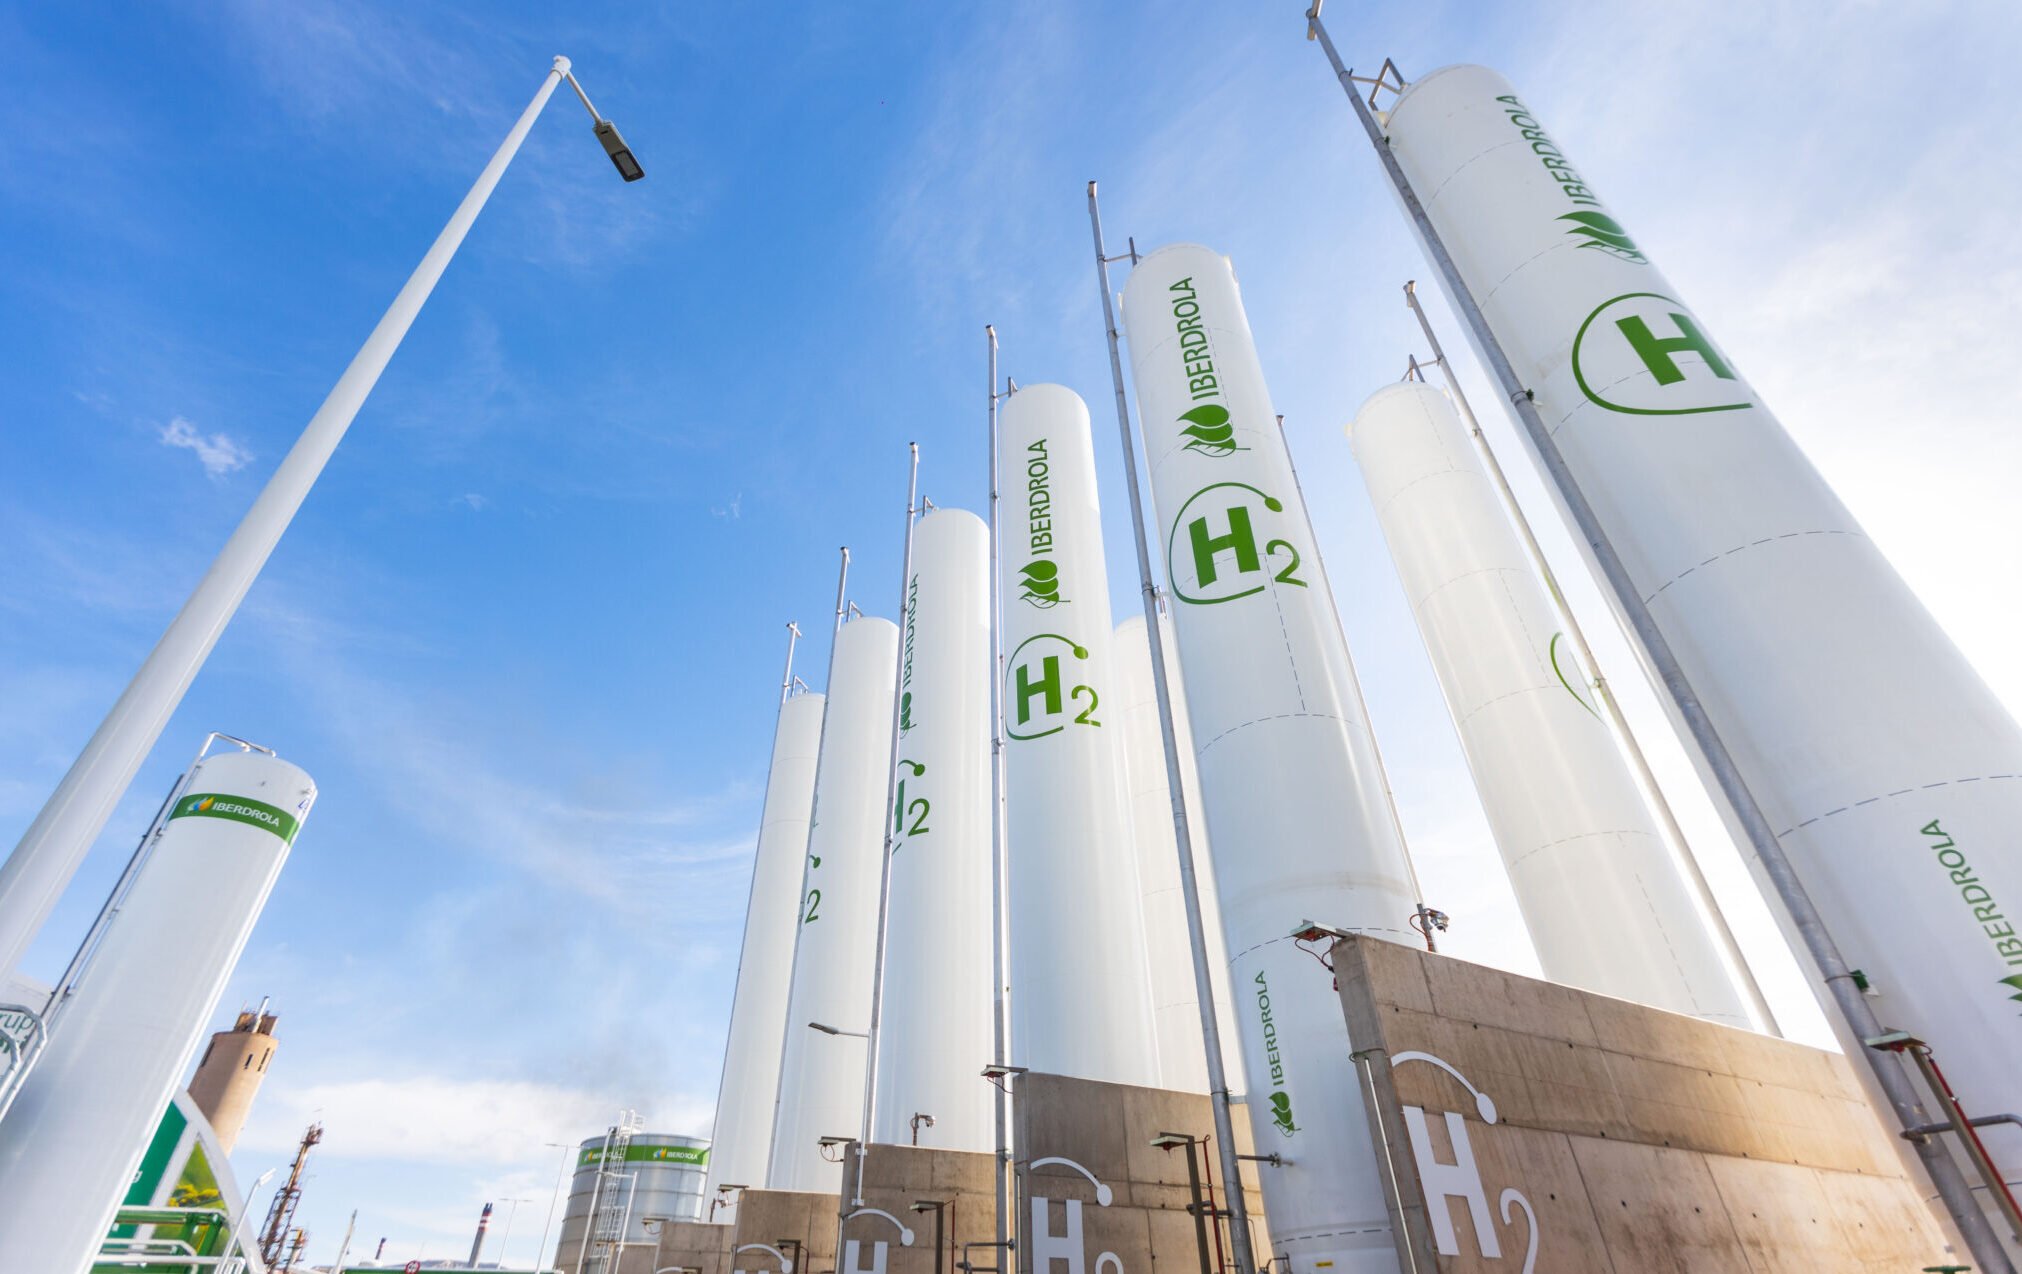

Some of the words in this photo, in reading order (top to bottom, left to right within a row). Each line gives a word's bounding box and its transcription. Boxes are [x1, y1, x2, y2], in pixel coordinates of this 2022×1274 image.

[1495, 95, 1602, 208] IBERDROLA
[1169, 277, 1218, 401] IBERDROLA
[1028, 438, 1053, 555] IBERDROLA
[212, 802, 280, 827] IBERDROLA
[1255, 970, 1285, 1086] IBERDROLA
